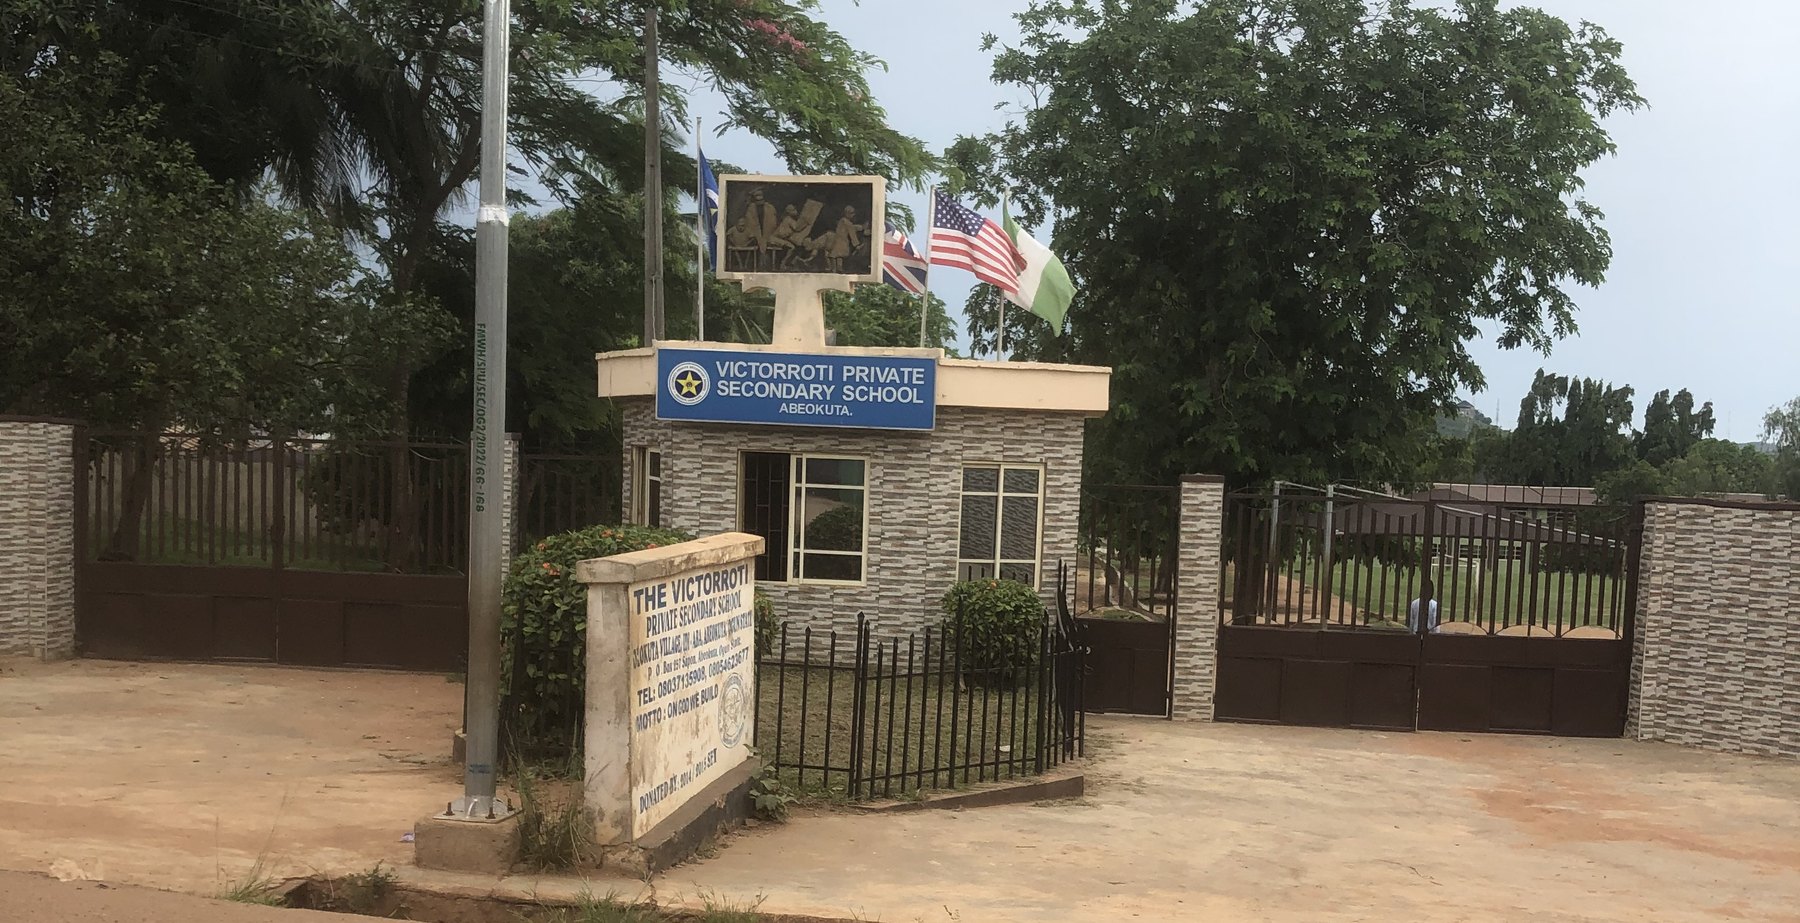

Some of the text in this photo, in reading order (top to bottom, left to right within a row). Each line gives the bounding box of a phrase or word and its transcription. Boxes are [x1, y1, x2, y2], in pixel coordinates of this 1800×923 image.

[716, 361, 925, 385] VICTORROTI PRIVATE
[717, 380, 835, 400] SECONDARY
[842, 385, 924, 404] SCHOOL
[779, 403, 853, 416] ABEOKUTA.
[633, 563, 748, 615] THE VICTORROTI
[646, 590, 741, 638] PRIVATE SECONDARY SCHOOL
[637, 688, 656, 707] TEL:
[667, 702, 678, 718] ON
[690, 693, 700, 712] WE
[701, 683, 719, 705] BUILD
[639, 781, 669, 814] DONATED
[707, 747, 718, 768] SET
